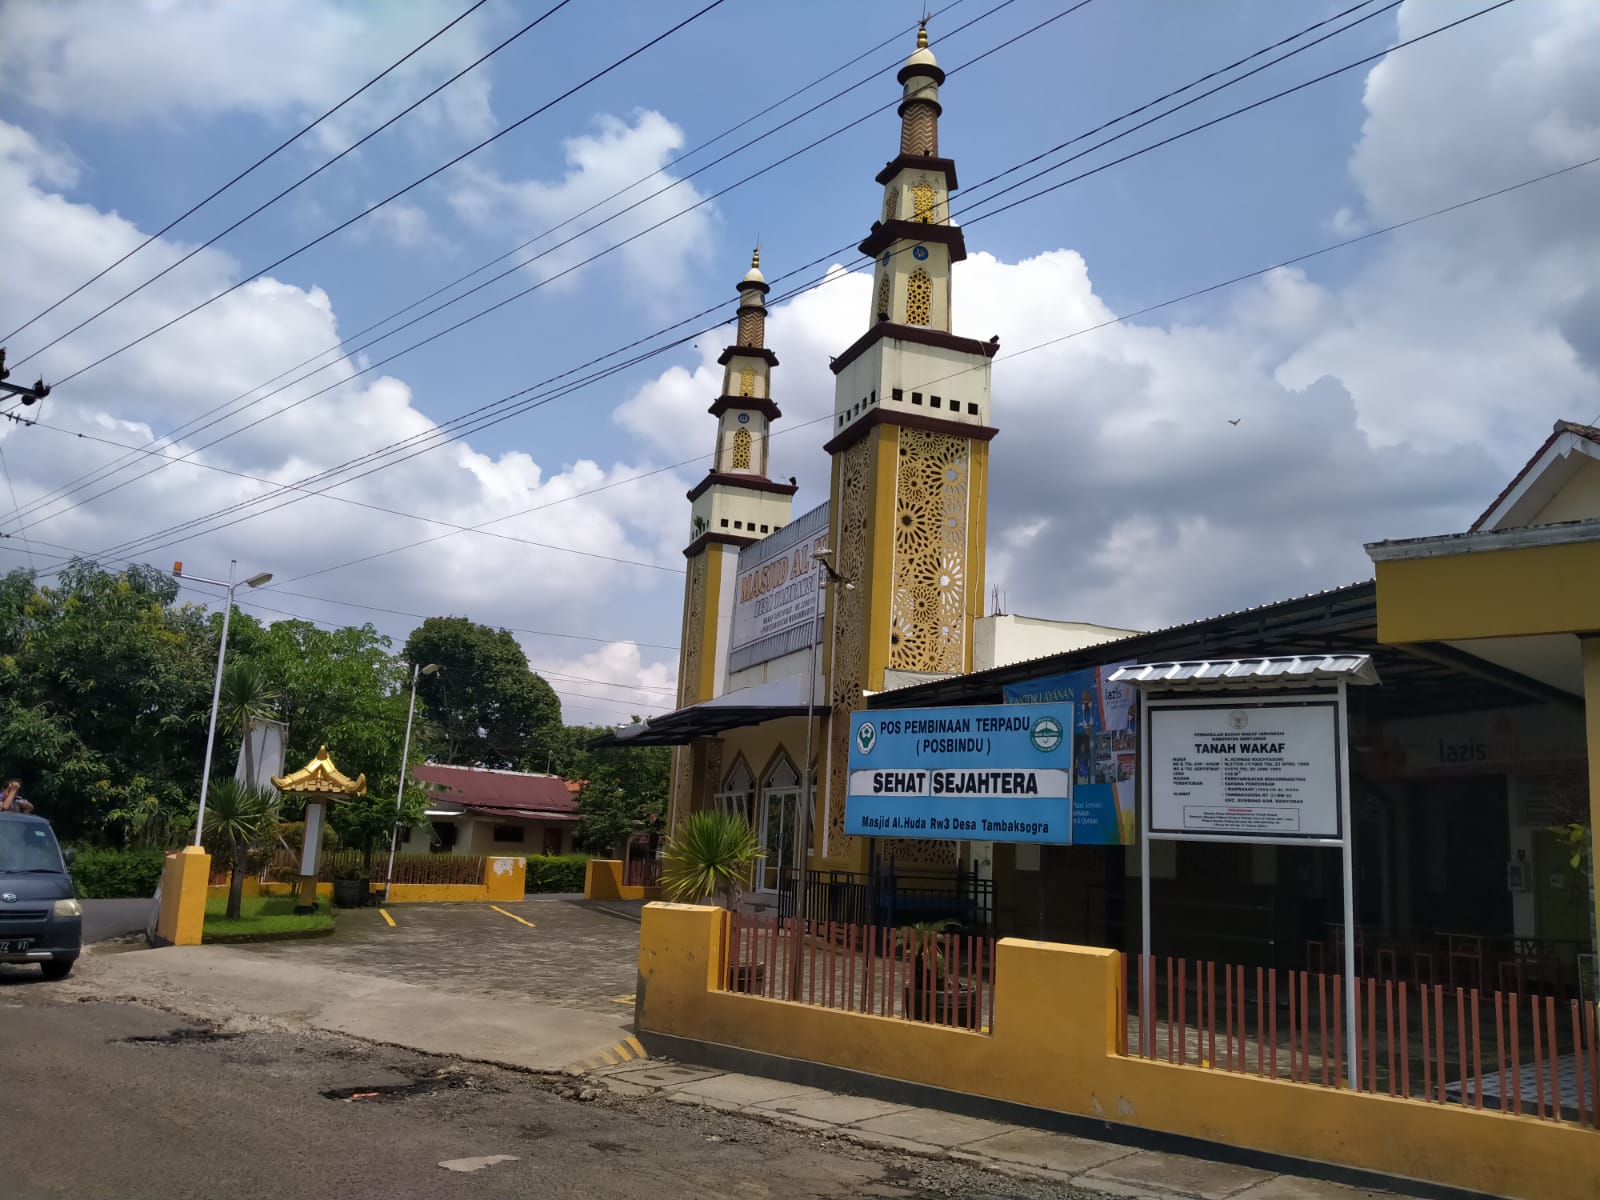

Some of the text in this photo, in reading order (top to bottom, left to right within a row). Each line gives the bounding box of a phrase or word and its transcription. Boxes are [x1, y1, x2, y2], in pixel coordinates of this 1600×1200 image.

[880, 716, 1030, 735] POS PEMBINAAN TERPADU
[1194, 743, 1285, 754] TANAH WAKAF
[873, 772, 1038, 794] SEHAT SEJAHTERA
[861, 816, 889, 830] Masjid
[930, 817, 950, 830] Rw3
[953, 819, 976, 830] Desa
[982, 819, 1049, 835] Tambaksogra
